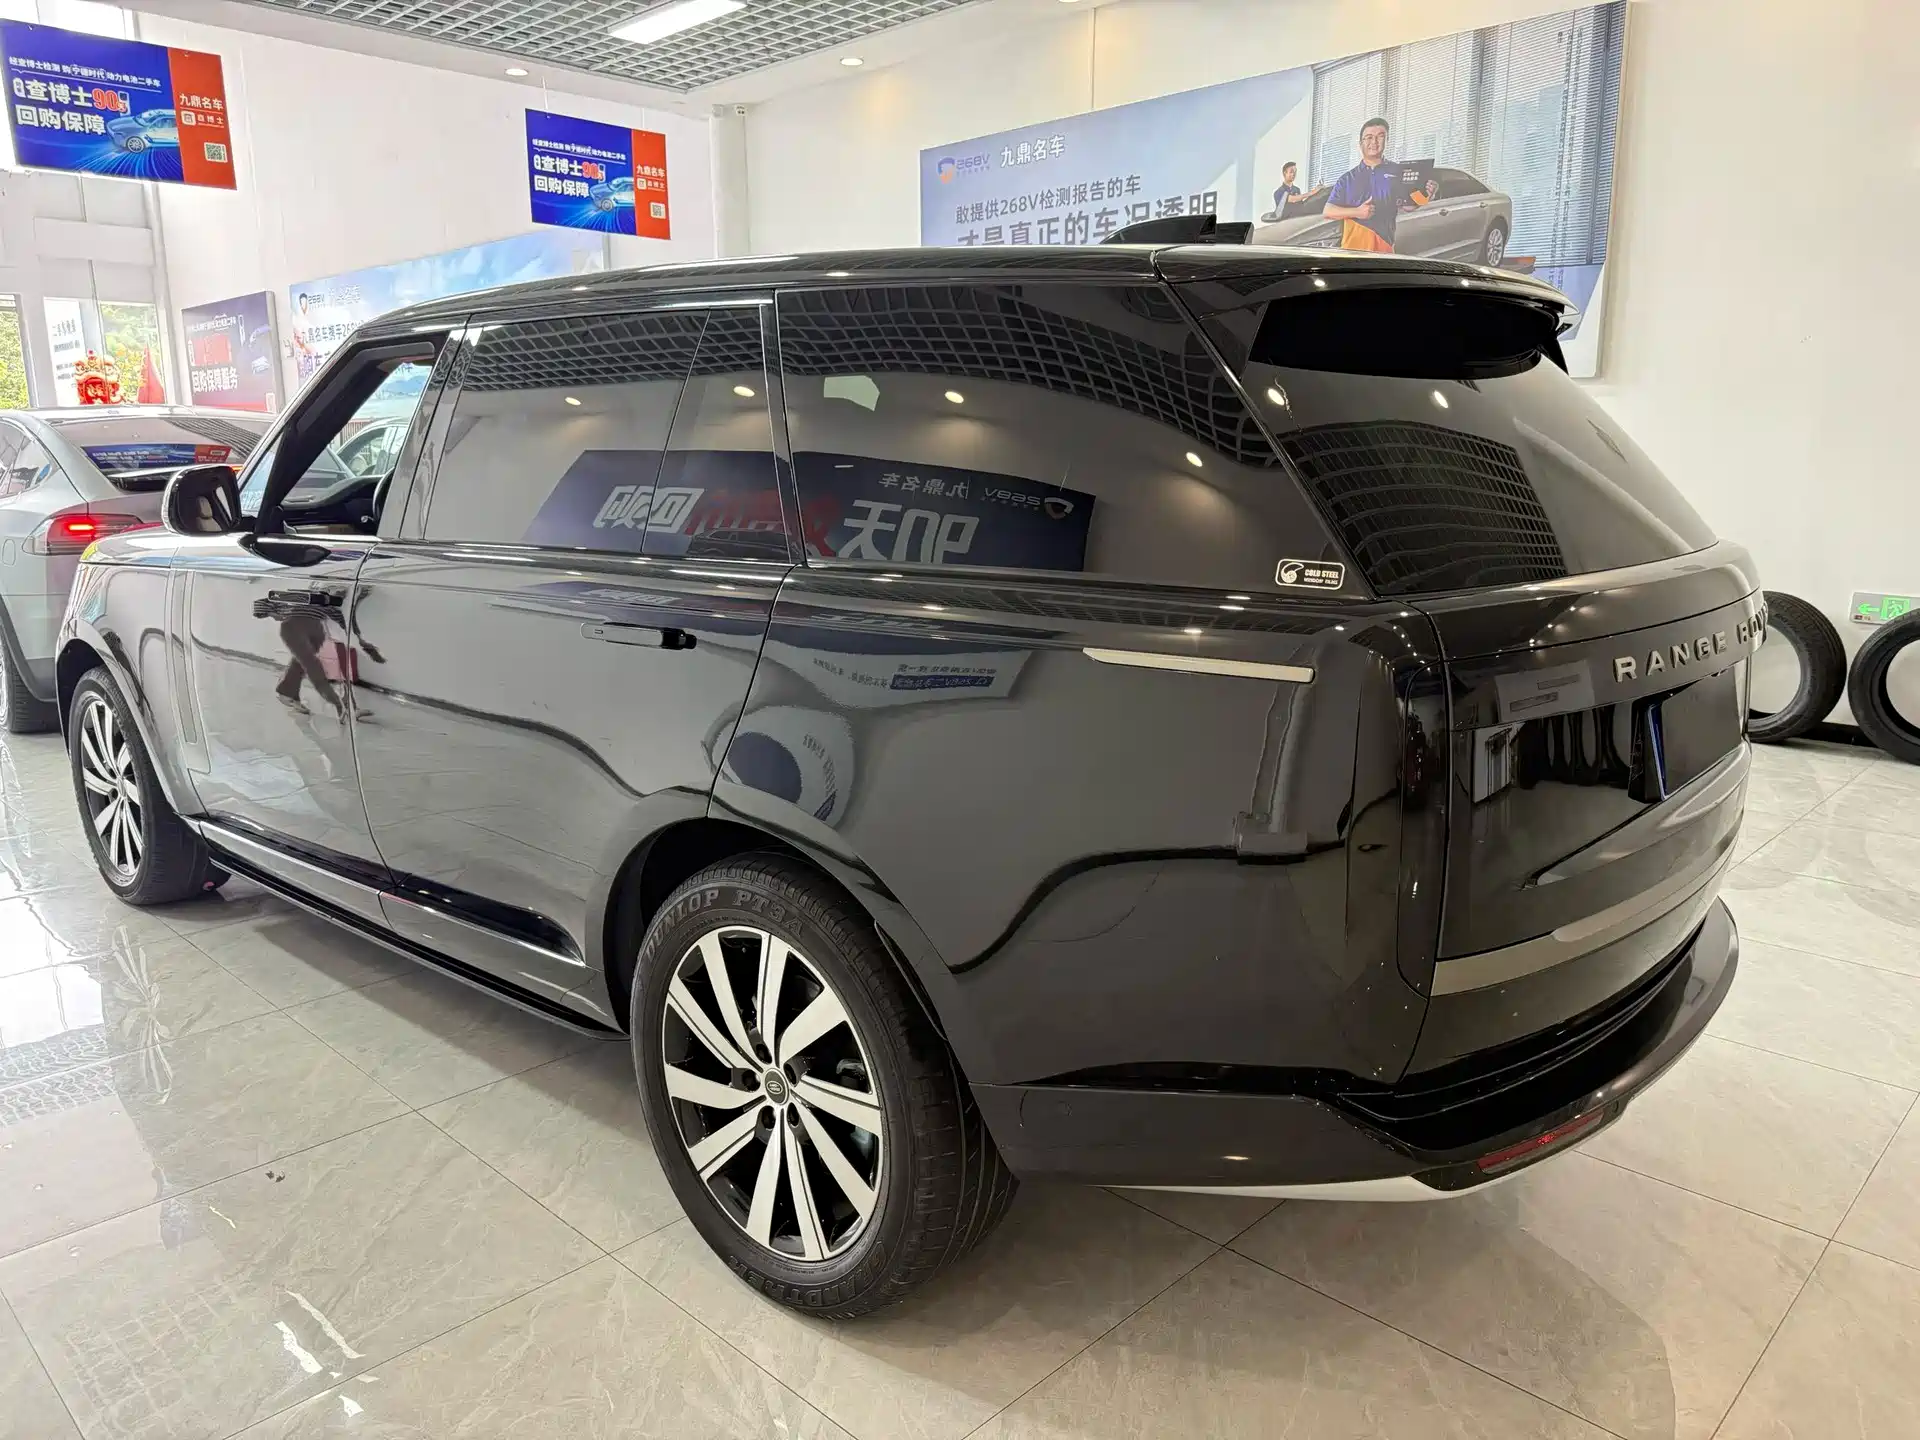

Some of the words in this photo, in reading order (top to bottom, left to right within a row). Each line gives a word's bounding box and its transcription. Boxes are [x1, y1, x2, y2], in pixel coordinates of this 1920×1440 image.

[179, 93, 224, 111] 九鼎名车
[15, 104, 107, 135] 回购保障
[956, 153, 991, 170] 268V
[1000, 134, 1065, 169] 九鼎名车
[533, 174, 589, 198] 回购保障
[955, 174, 1141, 225] 敢提供268V检测报告的车
[1612, 631, 1728, 683] RANGE
[645, 888, 720, 961] DUNLOP
